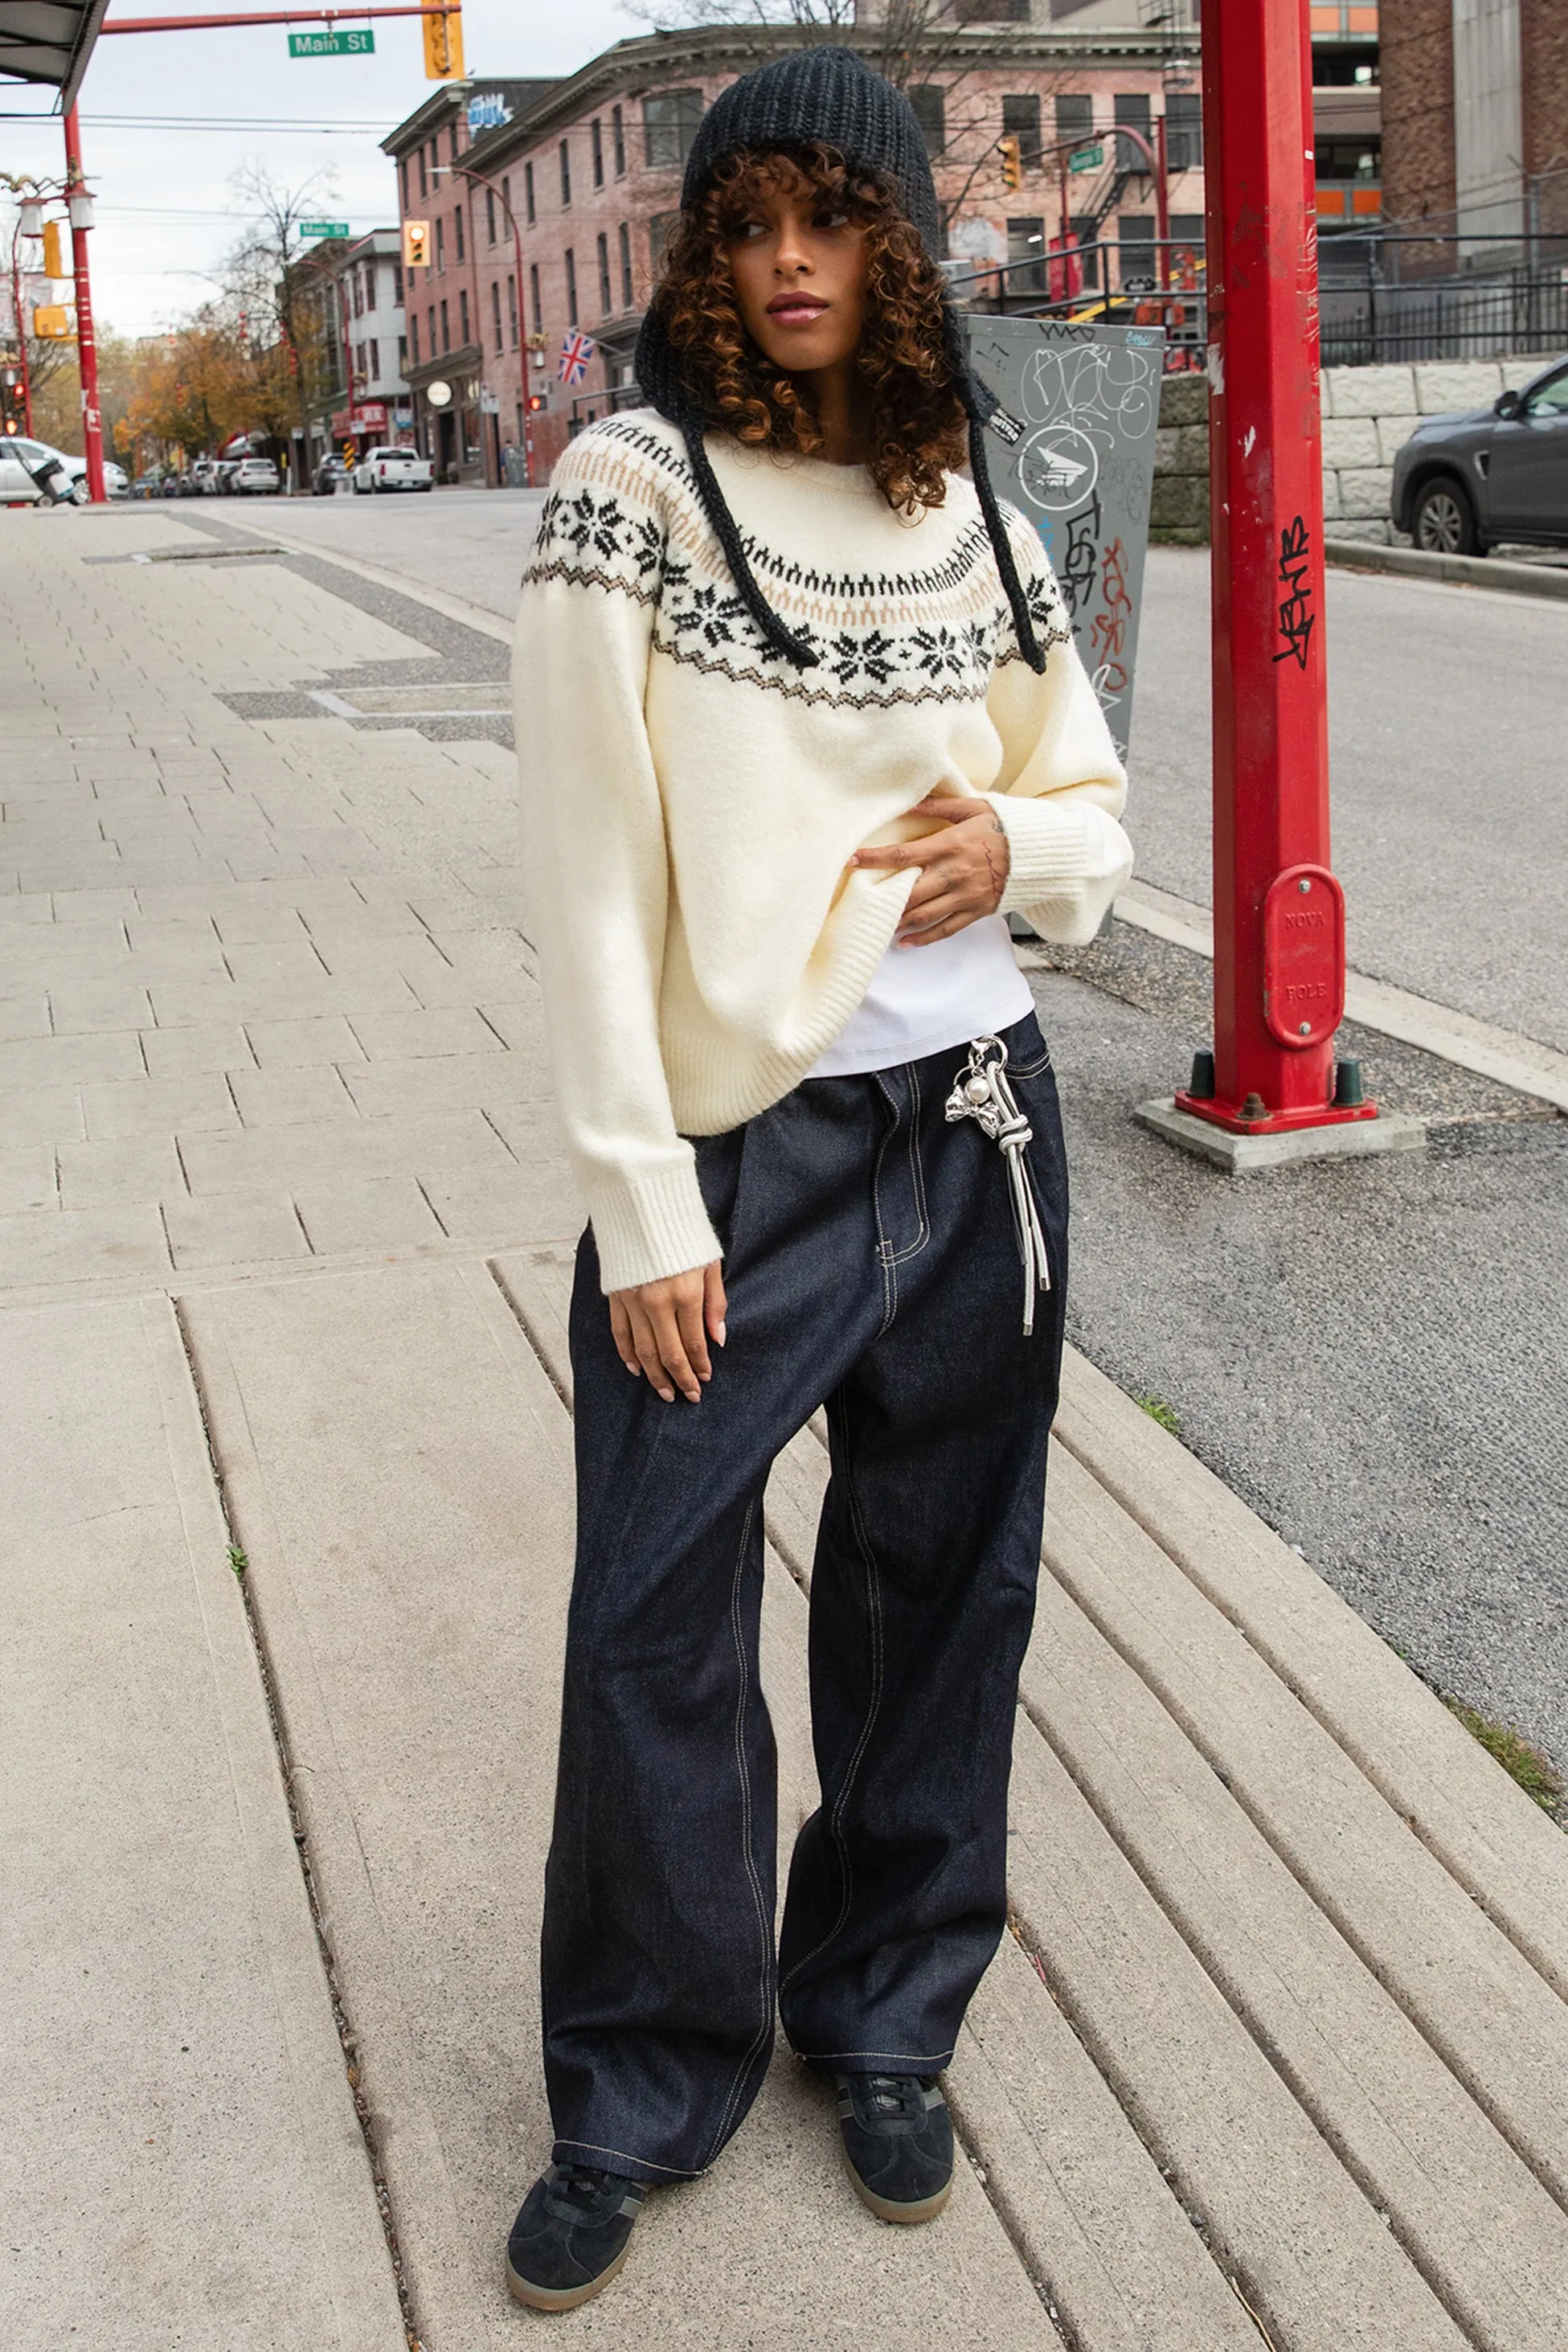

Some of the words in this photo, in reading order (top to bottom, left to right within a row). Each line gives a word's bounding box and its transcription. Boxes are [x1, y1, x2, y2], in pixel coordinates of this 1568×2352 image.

[295, 35, 339, 53] Main
[347, 33, 367, 50] St
[1285, 911, 1325, 929] NOVA
[1286, 982, 1327, 1003] POLE
